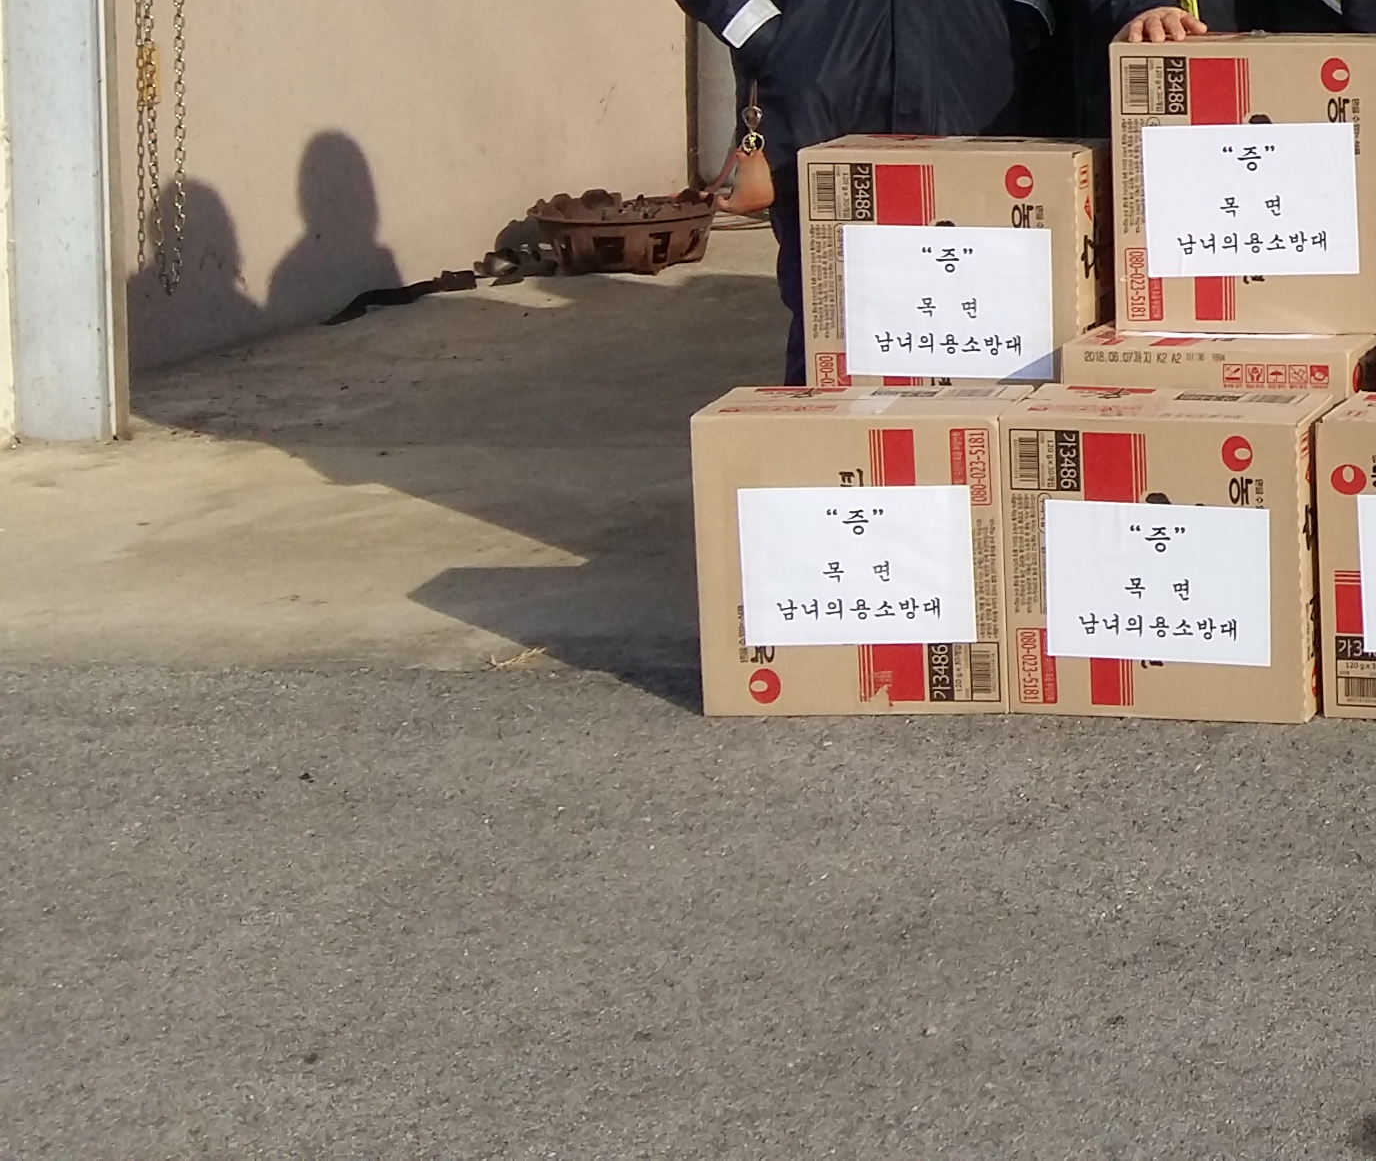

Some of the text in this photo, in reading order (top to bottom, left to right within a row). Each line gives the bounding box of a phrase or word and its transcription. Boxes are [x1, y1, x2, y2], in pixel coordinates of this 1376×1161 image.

[1167, 59, 1184, 112] 가3486
[854, 166, 870, 219] 가3486
[1219, 194, 1283, 218] 목 면
[916, 296, 979, 320] 목 면
[1131, 251, 1145, 319] 080-023-5181
[1157, 353, 1167, 363] K2
[1172, 353, 1182, 363] A2
[969, 431, 988, 503] 080-023-5181
[1060, 433, 1079, 489] 가3486
[821, 559, 892, 584] 목 면
[1124, 576, 1192, 602] 목 면
[932, 644, 950, 699] 가3486
[1020, 631, 1040, 703] 080-023-5181
